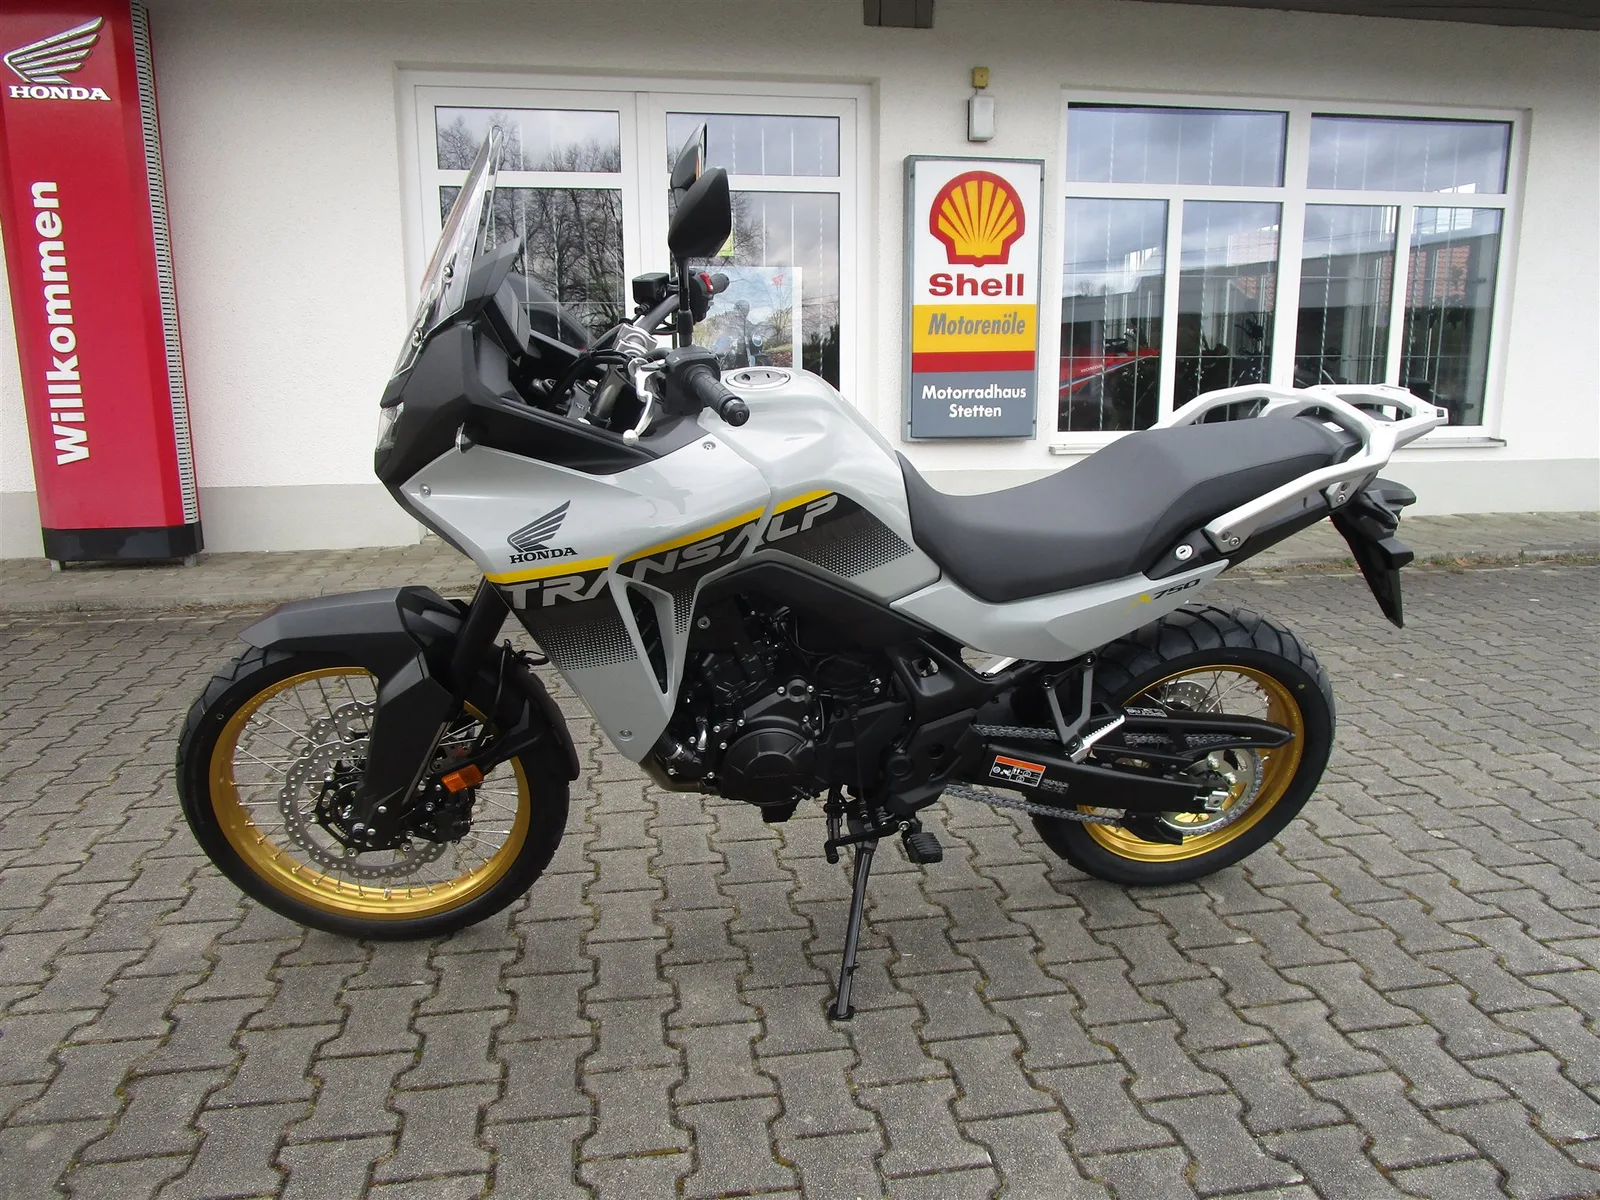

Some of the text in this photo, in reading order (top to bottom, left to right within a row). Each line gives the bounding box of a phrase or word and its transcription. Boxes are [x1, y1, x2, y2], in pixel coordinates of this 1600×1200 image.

[8, 85, 111, 101] HONDA
[928, 273, 1024, 296] Shell
[32, 181, 90, 465] Willkommen
[928, 311, 1025, 335] Motorenöle
[922, 384, 1027, 400] Motorradhaus
[949, 404, 1002, 418] Stetten
[501, 494, 838, 610] TRANSALP
[509, 547, 578, 564] HONDA
[1153, 578, 1201, 600] 750
